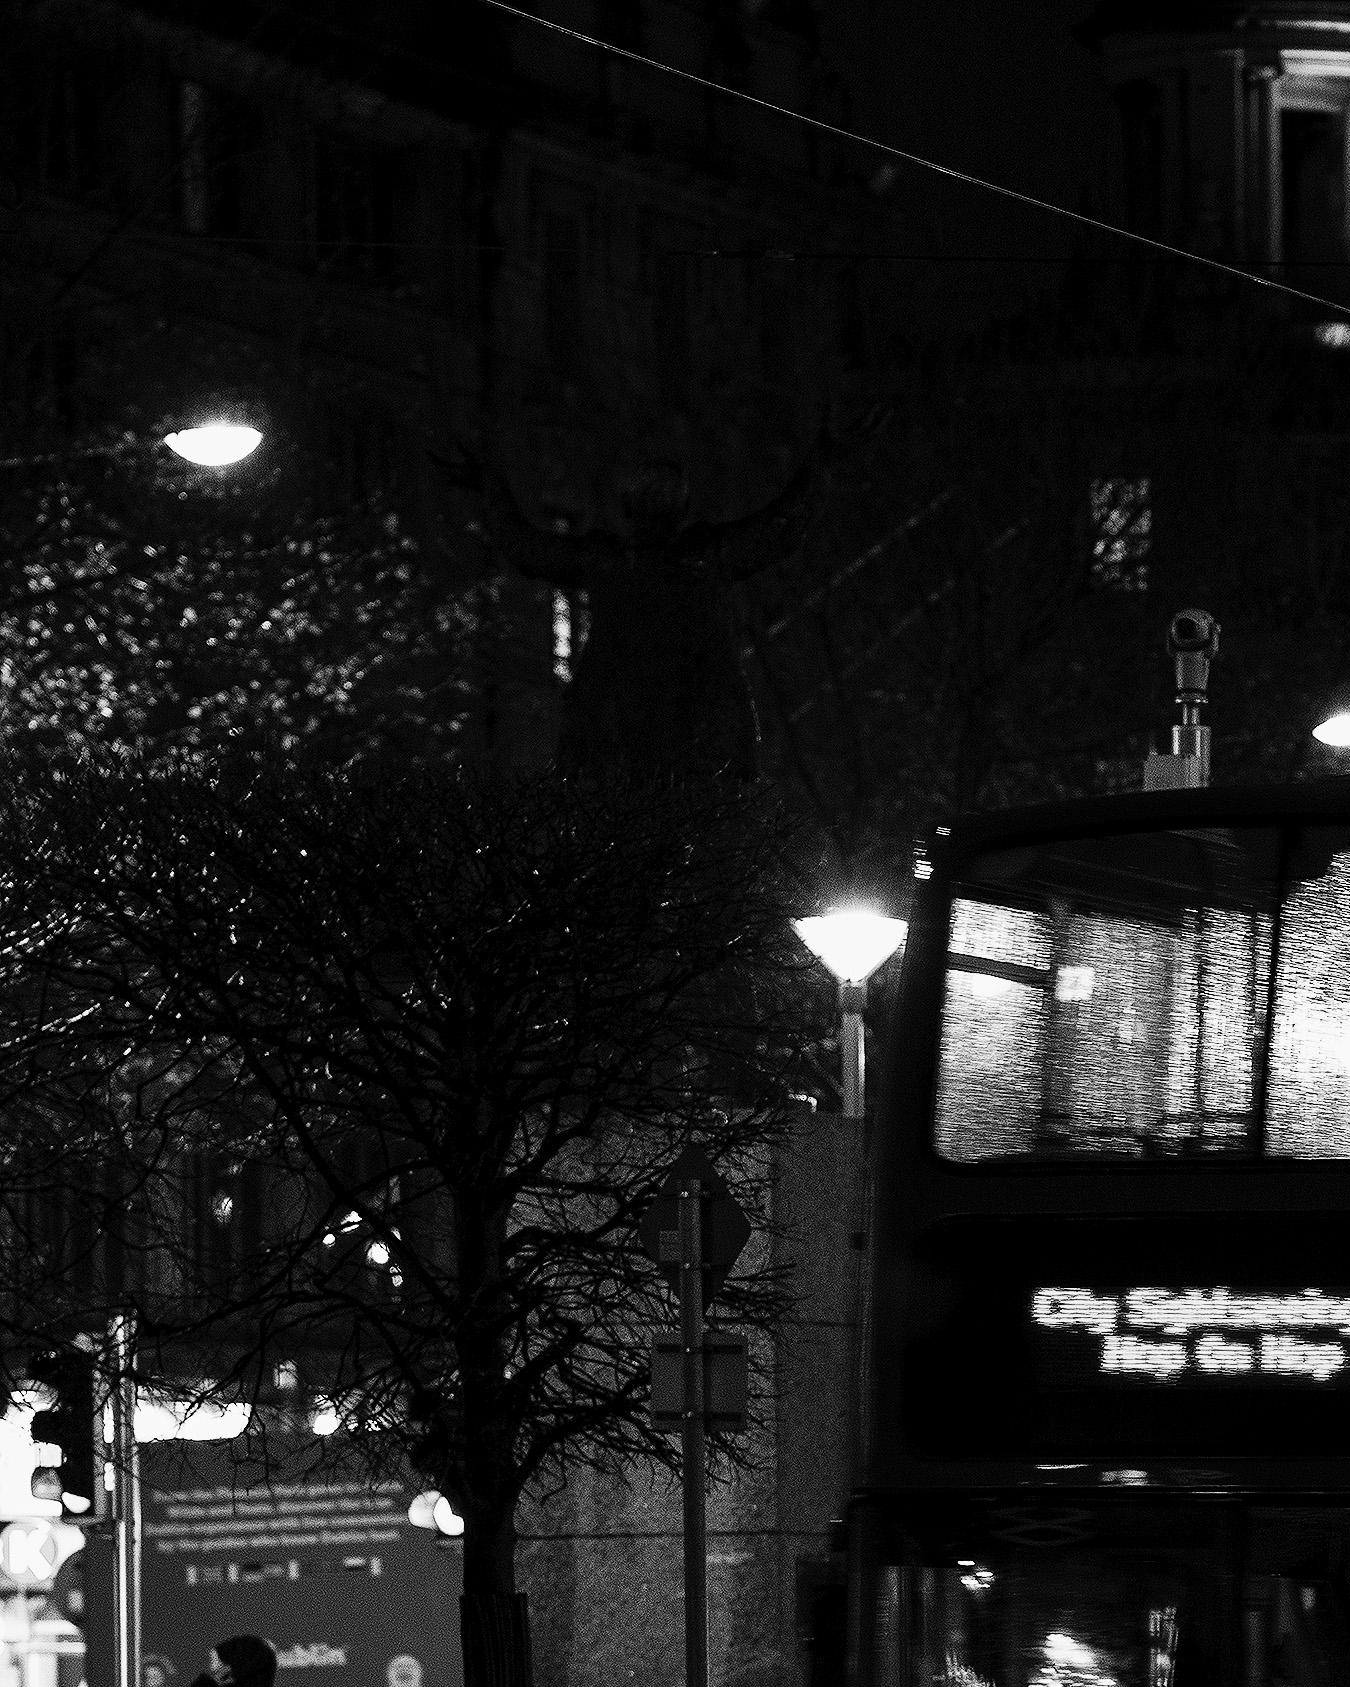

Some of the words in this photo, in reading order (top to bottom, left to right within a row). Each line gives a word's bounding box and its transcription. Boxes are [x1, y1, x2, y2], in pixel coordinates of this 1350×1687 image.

[1032, 1287, 1117, 1335] City
[1099, 1335, 1188, 1382] Hop
[1195, 1334, 1253, 1372] On
[1259, 1334, 1345, 1381] Hop
